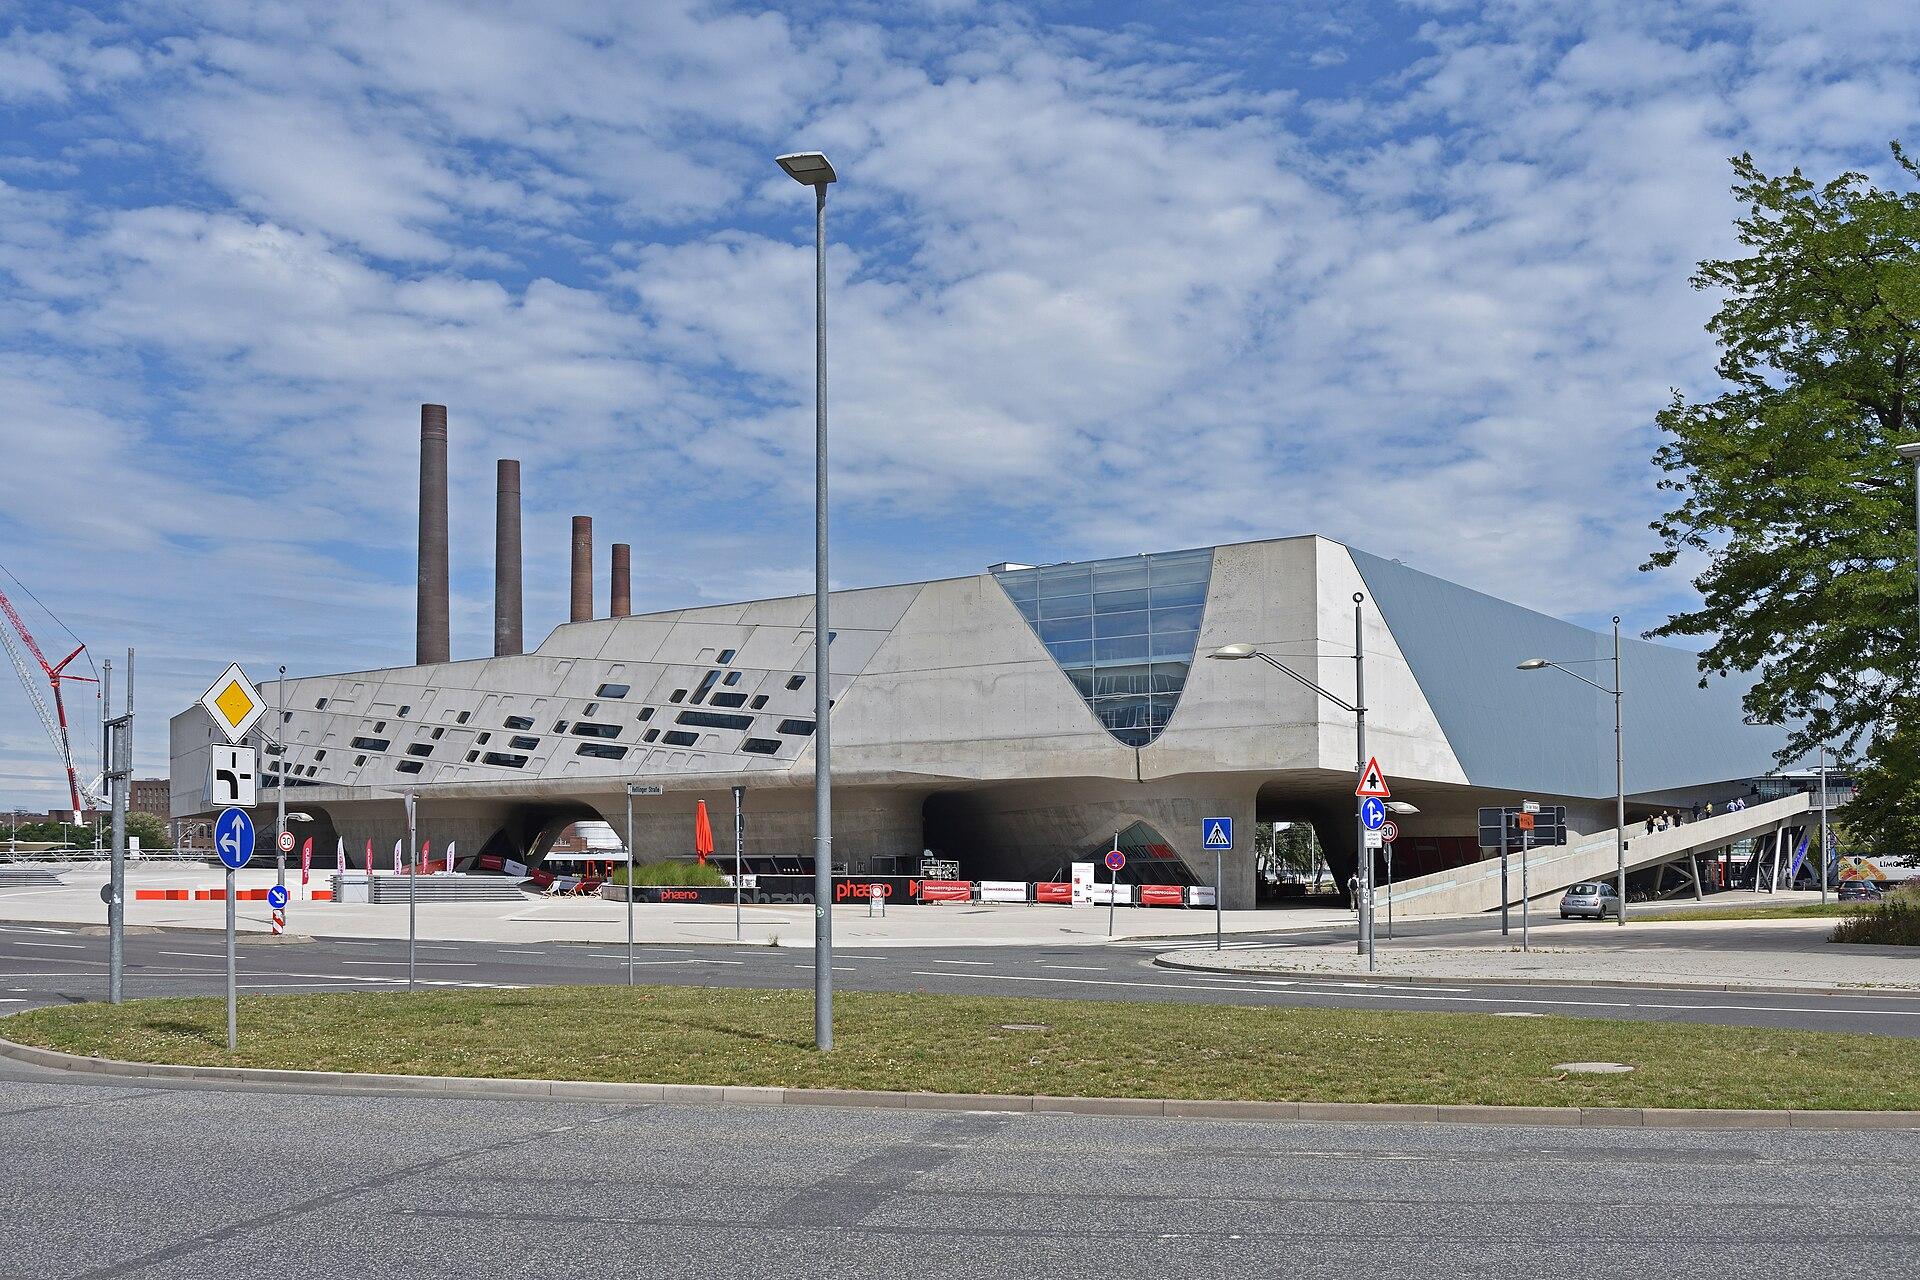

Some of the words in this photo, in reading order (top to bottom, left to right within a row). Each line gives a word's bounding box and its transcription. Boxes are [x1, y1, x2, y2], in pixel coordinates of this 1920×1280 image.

[1382, 826, 1393, 836] 30
[282, 837, 291, 846] 30
[836, 880, 893, 901] phæo
